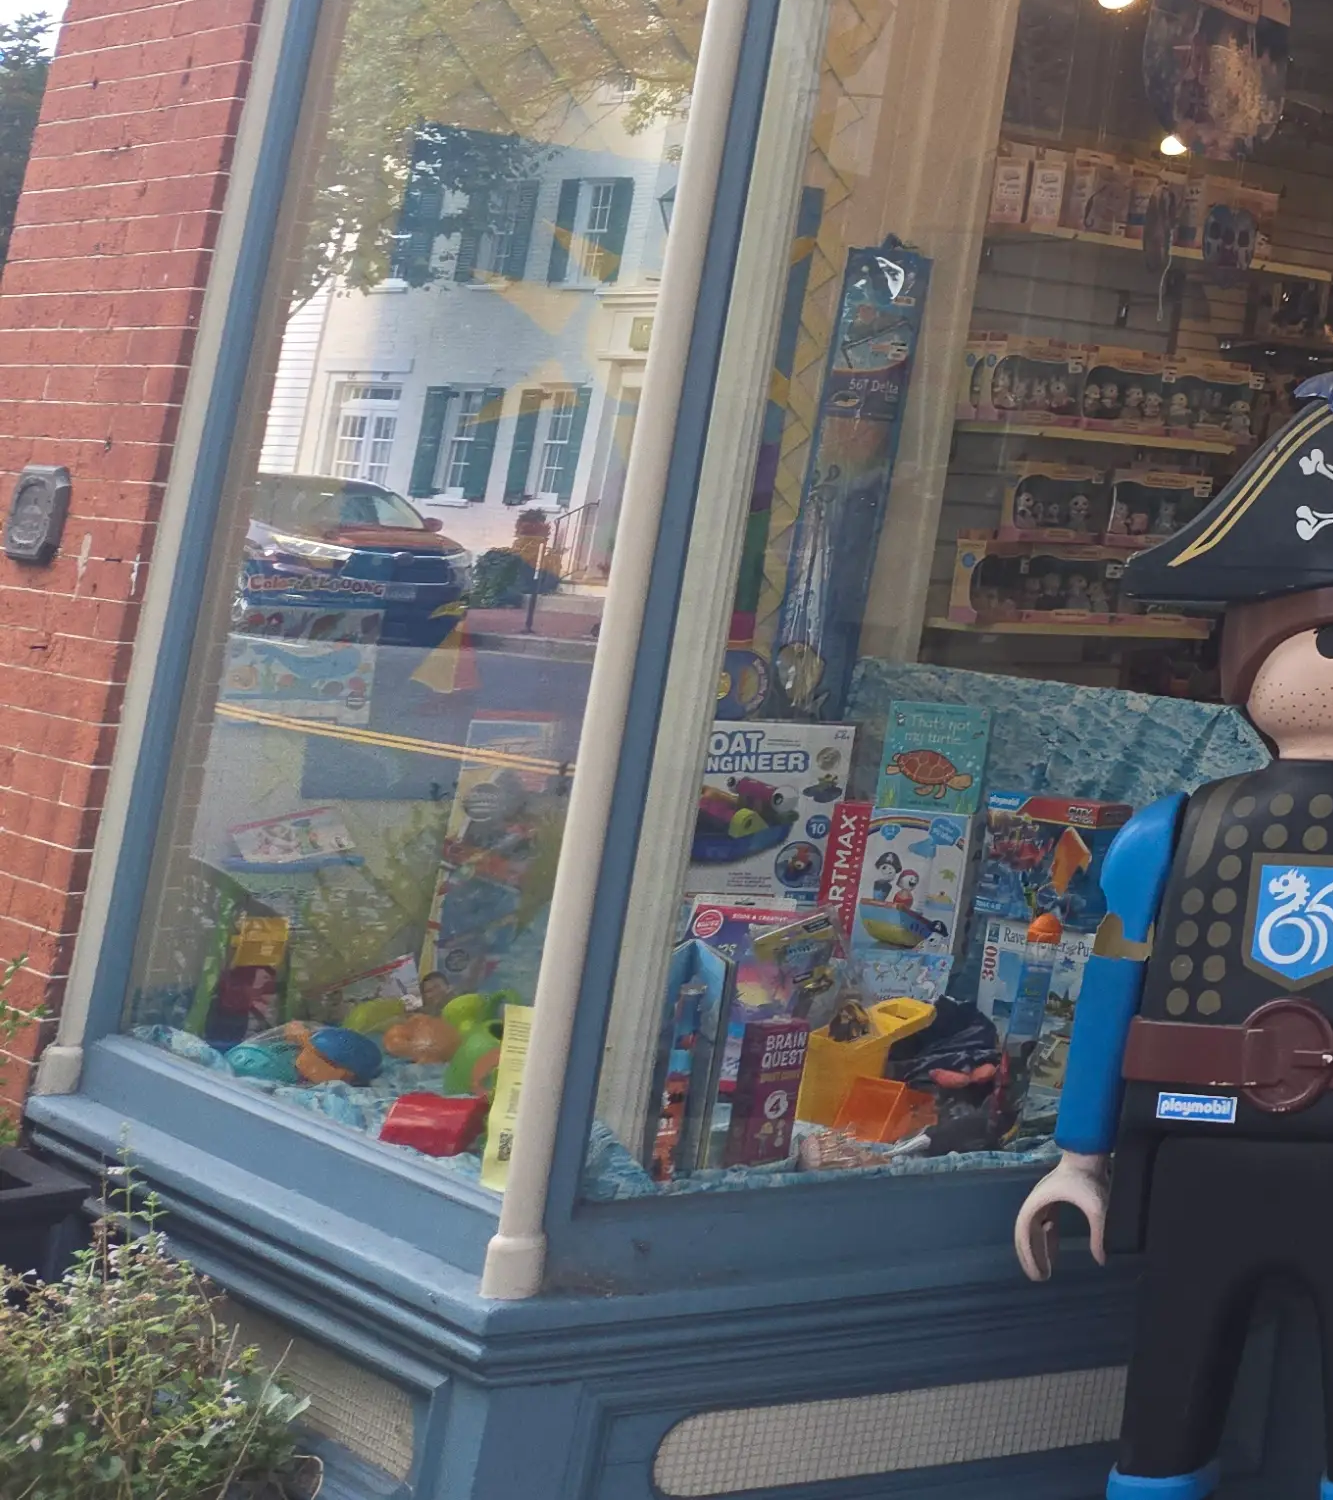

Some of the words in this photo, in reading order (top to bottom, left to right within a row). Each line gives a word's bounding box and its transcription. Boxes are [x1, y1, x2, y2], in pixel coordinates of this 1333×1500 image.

[911, 713, 946, 732] That's
[709, 731, 765, 756] OAT
[904, 732, 926, 745] my
[706, 752, 808, 772] NGINEER
[810, 822, 827, 835] 10
[828, 811, 859, 908] RTMAX
[982, 945, 998, 981] 300
[766, 1031, 808, 1051] BRAIN
[761, 1050, 806, 1069] QUEST
[768, 1097, 781, 1115] 4
[1159, 1097, 1232, 1116] playmobil
